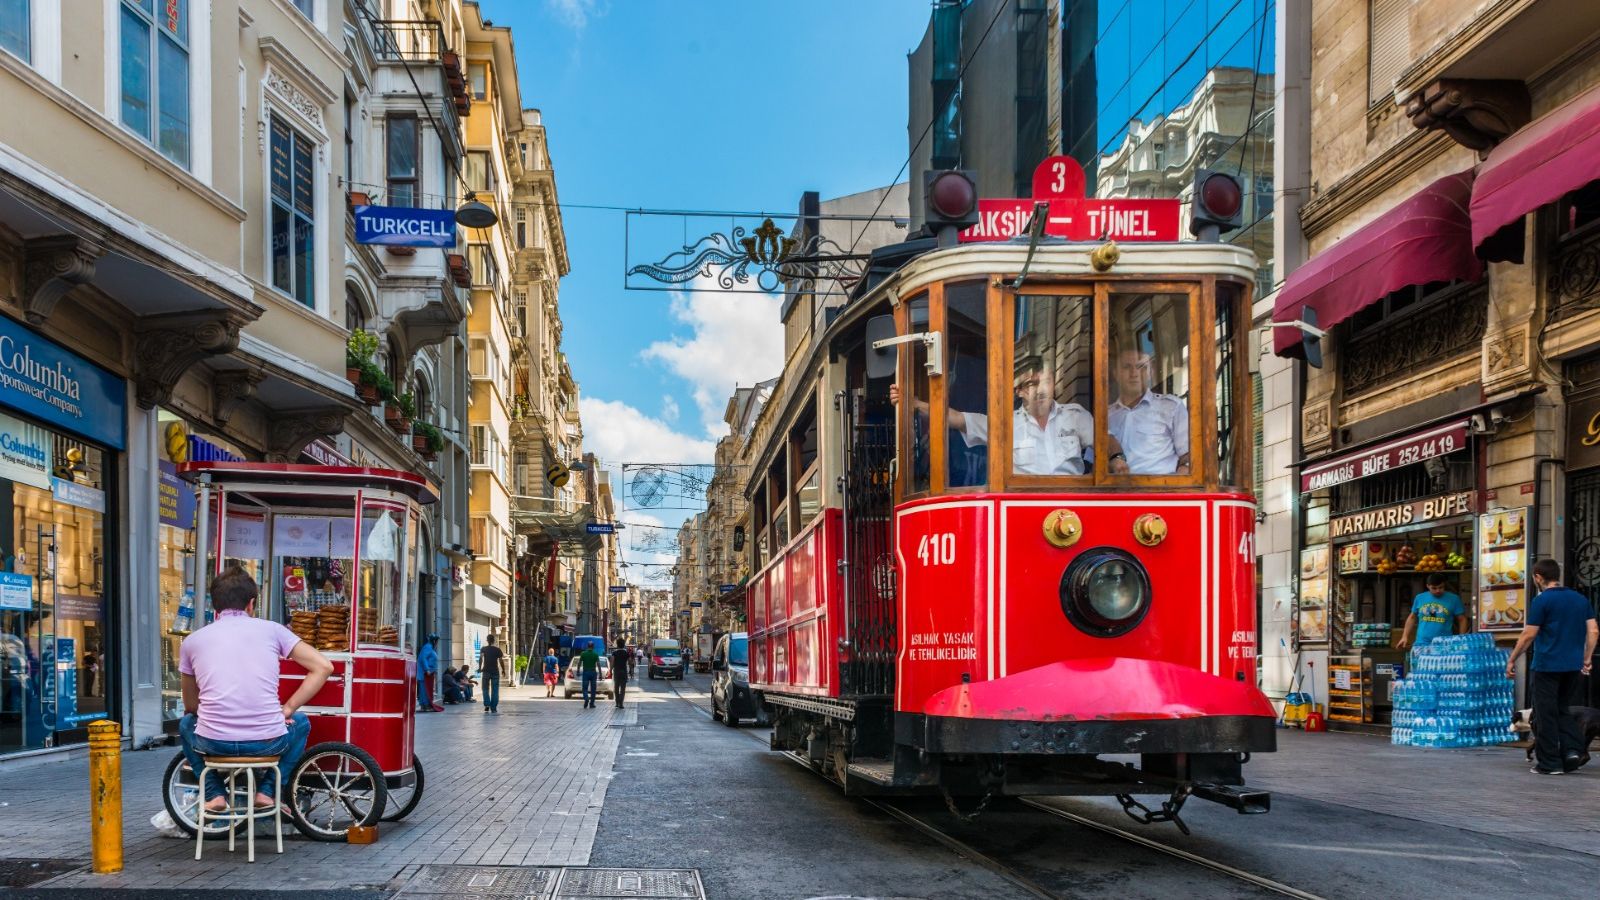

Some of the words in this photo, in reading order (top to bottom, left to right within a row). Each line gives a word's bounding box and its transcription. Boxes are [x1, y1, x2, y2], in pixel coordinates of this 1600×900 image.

[1052, 162, 1066, 193] 3
[360, 216, 451, 237] TURKCELL
[964, 206, 1034, 237] AKSİ
[1087, 206, 1157, 236] TÜNEL
[0, 336, 80, 400] Columbia
[1, 433, 46, 462] Columbia
[1309, 462, 1354, 490] MARMARİS
[1362, 454, 1390, 476] BÜFE
[1398, 445, 1419, 466] 252
[1421, 440, 1435, 458] 44
[1438, 435, 1454, 453] 19
[1333, 504, 1413, 537] MARMARİS
[1422, 493, 1469, 521] BÜFE
[917, 532, 956, 567] 410
[909, 648, 916, 662] VE
[918, 646, 977, 662] TEHLİKELİDİR
[911, 632, 940, 646] ASILMAK
[943, 632, 975, 645] YASAK
[1227, 646, 1239, 659] VE
